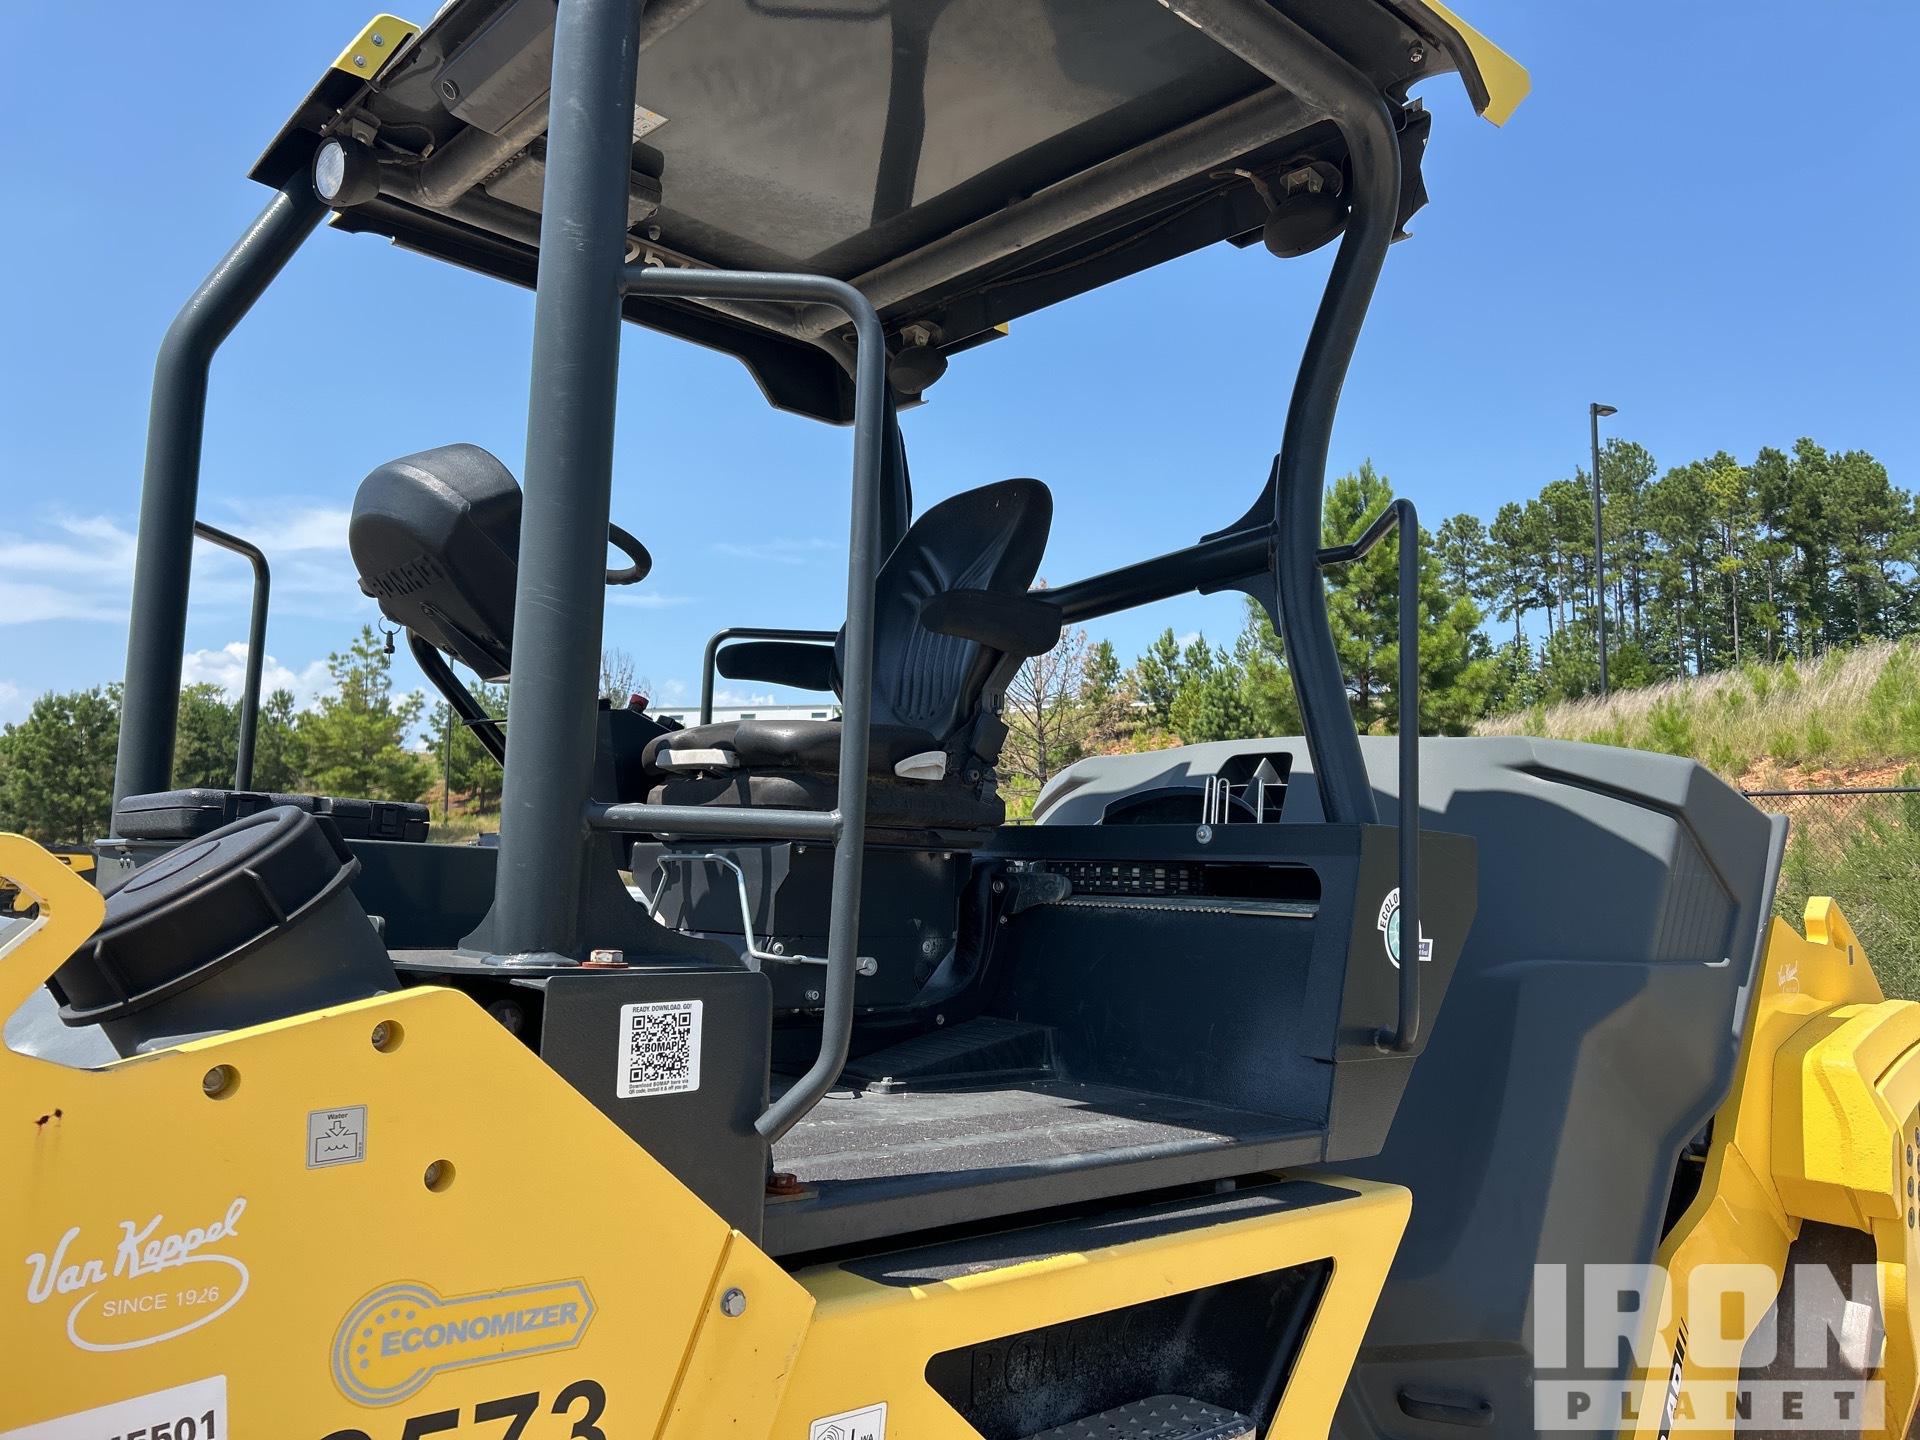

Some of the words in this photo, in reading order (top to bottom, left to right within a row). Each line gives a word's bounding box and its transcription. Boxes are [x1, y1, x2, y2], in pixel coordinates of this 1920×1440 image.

[25, 1226, 107, 1303] Van
[113, 1197, 247, 1279] Keppel
[102, 1293, 168, 1317] SINCE
[175, 1286, 219, 1307] 1926
[380, 1302, 579, 1357] ECONOMIZER
